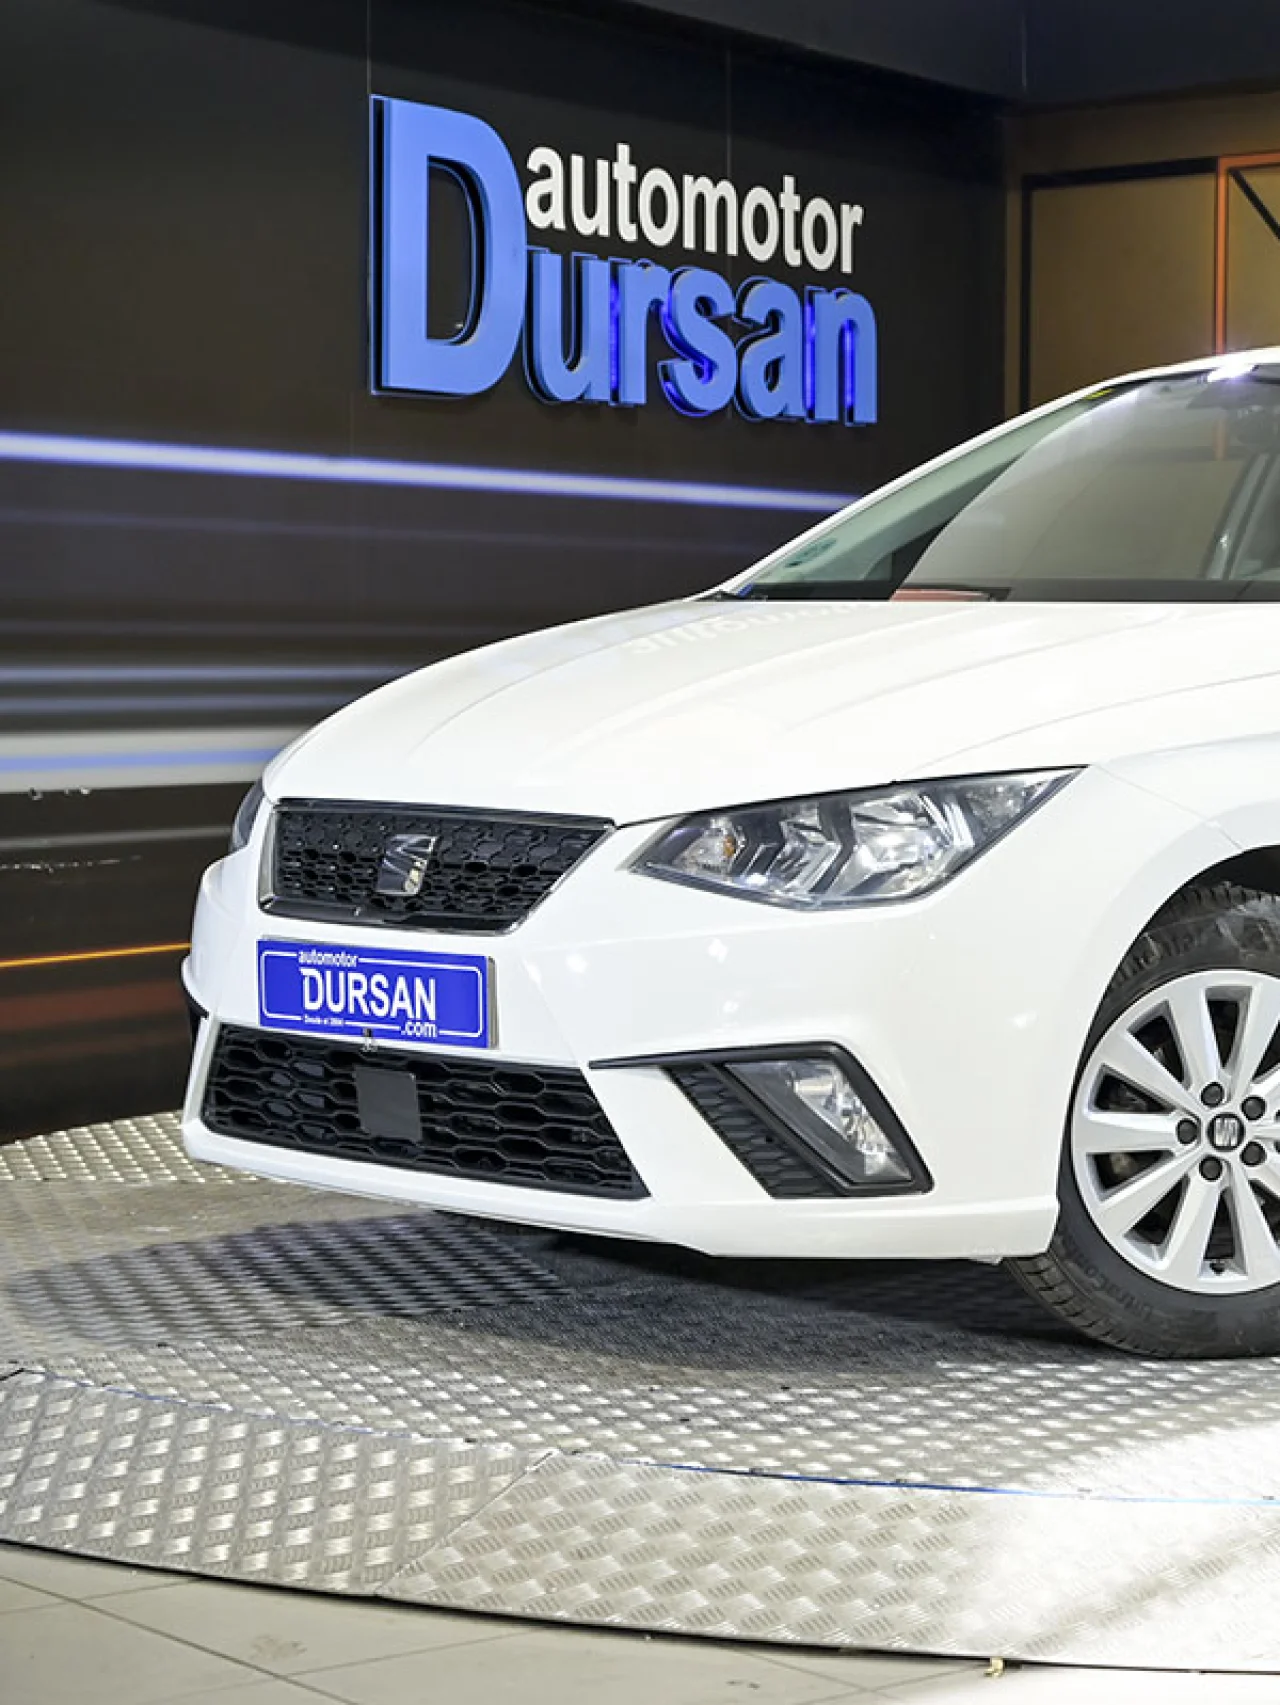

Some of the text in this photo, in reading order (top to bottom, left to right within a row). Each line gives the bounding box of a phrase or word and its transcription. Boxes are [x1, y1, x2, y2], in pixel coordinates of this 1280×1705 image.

[525, 143, 863, 274] automotor
[369, 93, 878, 426] Dursan
[299, 949, 358, 967] automotor
[300, 967, 436, 1021] DURSAN
[400, 1021, 438, 1038] .com
